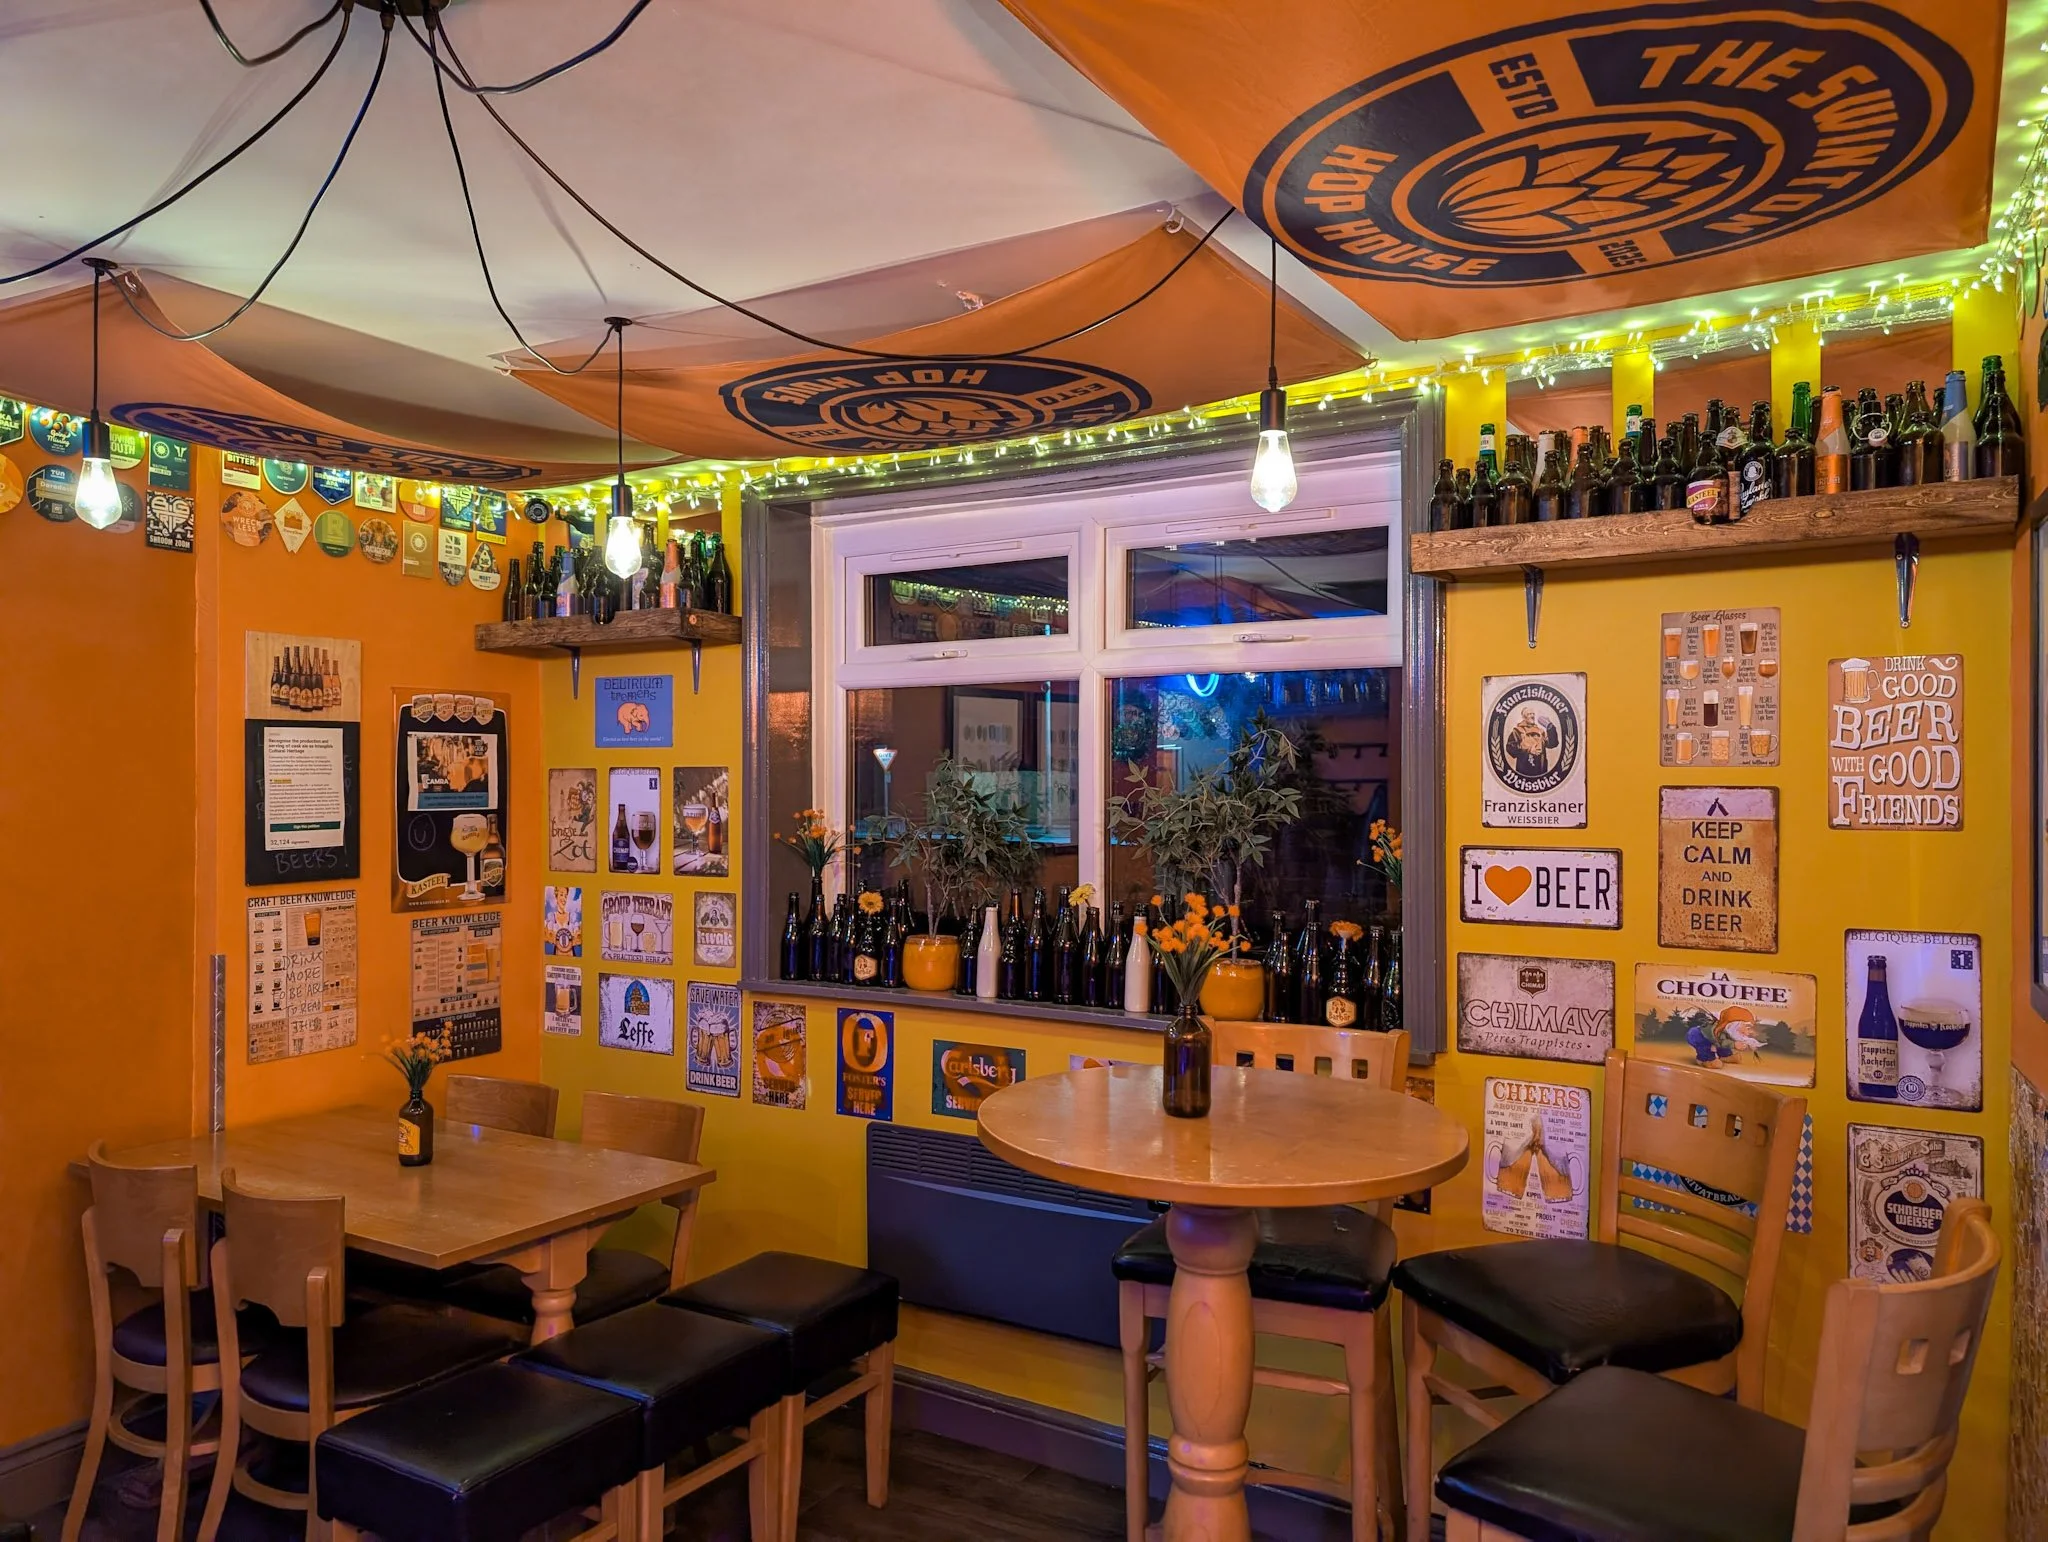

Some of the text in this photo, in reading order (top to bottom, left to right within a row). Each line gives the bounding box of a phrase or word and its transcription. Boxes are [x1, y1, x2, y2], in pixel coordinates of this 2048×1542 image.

[1640, 39, 1826, 93] THE
[1703, 64, 1899, 234] SWINTON
[1304, 144, 1399, 213] HOP
[1314, 218, 1501, 276] HOUSE
[873, 369, 988, 385] HOP
[761, 376, 866, 406] HOUS
[227, 452, 258, 467] BITTER
[1690, 610, 1747, 624] Beer Glasses
[1884, 656, 1927, 672] DRINK
[603, 677, 663, 690] DELIRIUM
[1882, 673, 1957, 700] GOOD
[1495, 685, 1569, 717] Franziskaner
[1831, 700, 1960, 750] BEER
[1831, 745, 1961, 790] WITH GOOD
[1503, 769, 1562, 792] Weissbier
[1484, 799, 1584, 814] Franziskaner
[1832, 776, 1960, 827] FRIENDS
[1507, 815, 1560, 825] WEISSBIER
[1691, 821, 1743, 839] KEEP
[553, 839, 596, 861] Zot
[1683, 845, 1751, 865] CALM
[410, 875, 448, 895] KASTEEL
[1701, 871, 1732, 882] AND
[1471, 864, 1611, 911] I BEER
[248, 890, 356, 908] CRAFT BEER KNOWLEDGE
[1682, 888, 1752, 908] DRINK
[603, 895, 673, 921] GROUP THERAPY
[412, 911, 501, 929] BEER KNOWLEDGE
[1690, 913, 1742, 932] BEER
[1851, 932, 1975, 946] BELGIQUE-BELGIE
[1957, 953, 1965, 966] 1
[1711, 972, 1730, 982] LA
[690, 988, 739, 1006] SAVE WATER
[1657, 979, 1788, 1003] CHOUFFE
[1464, 998, 1608, 1037] CHIMAY
[618, 1017, 655, 1047] Leffe
[1519, 1034, 1583, 1050] Trappistes
[1860, 1042, 1896, 1056] Trappistes
[941, 1049, 1017, 1086] Carlsberg
[690, 1071, 737, 1089] DRINK BEER
[843, 1073, 887, 1087] FOSTER'S
[1907, 1083, 1917, 1092] 10
[768, 1091, 790, 1104] HERE
[1492, 1081, 1582, 1111] CHEERS
[853, 1101, 876, 1116] HERE
[1535, 1212, 1556, 1221] PROOST
[1886, 1202, 1943, 1220] SCHNEIDER
[1896, 1215, 1934, 1229] WEISSE
